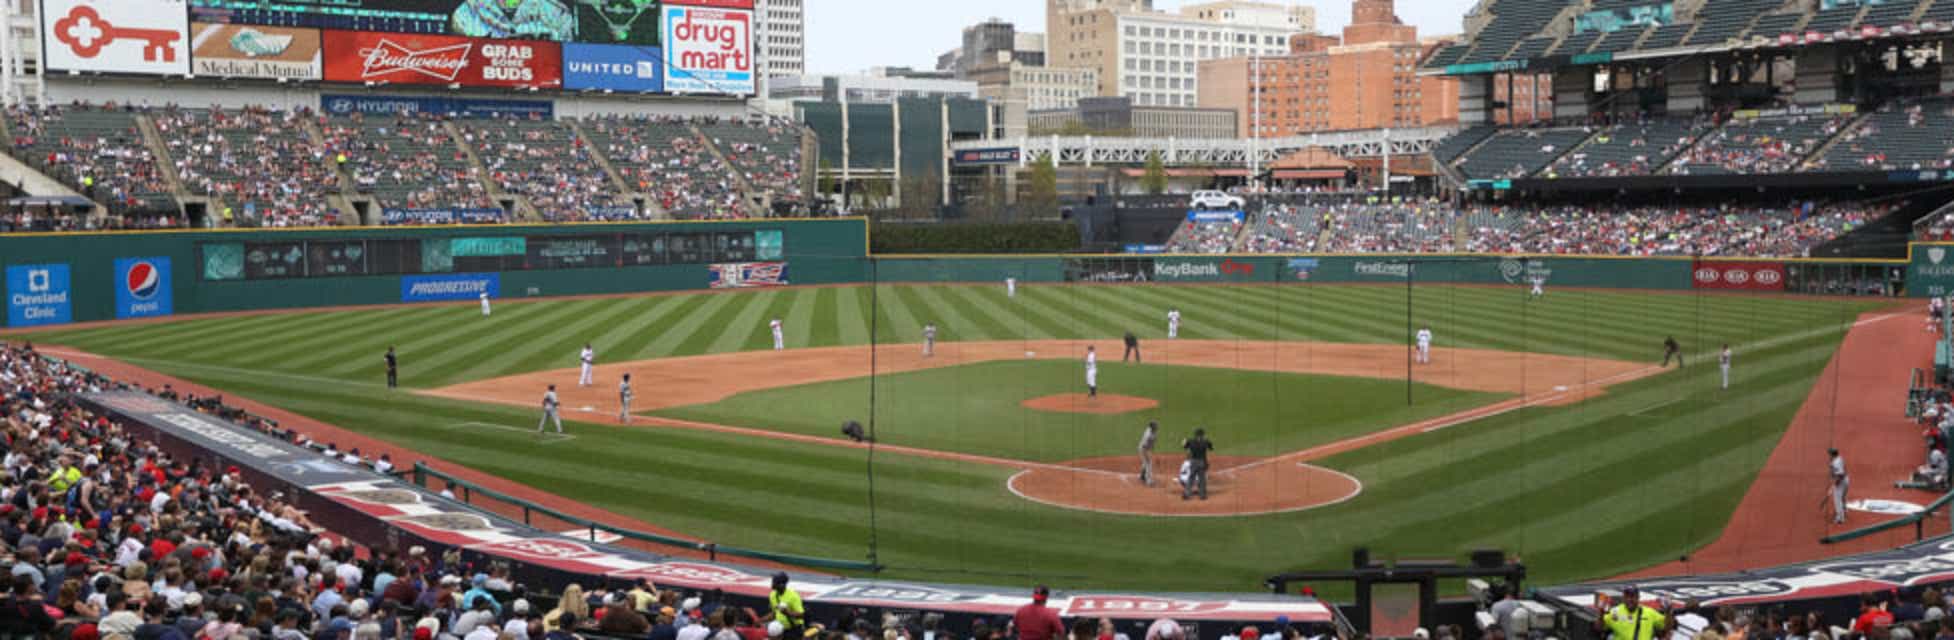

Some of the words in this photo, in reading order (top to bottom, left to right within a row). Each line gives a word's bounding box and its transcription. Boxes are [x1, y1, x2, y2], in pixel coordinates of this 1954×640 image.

[675, 9, 736, 50] drug
[359, 47, 470, 69] Budweiser
[482, 44, 533, 59] GRAB
[681, 49, 749, 71] mart
[201, 61, 260, 76] Medical
[263, 63, 314, 78] Mutual
[482, 66, 534, 81] BUDS
[568, 61, 634, 75] UNITED
[357, 101, 419, 113] HYUNDAI
[1154, 263, 1218, 277] KeyBank
[13, 292, 66, 305] Cleveland
[24, 306, 56, 319] Clinic
[130, 302, 159, 315] pepsi
